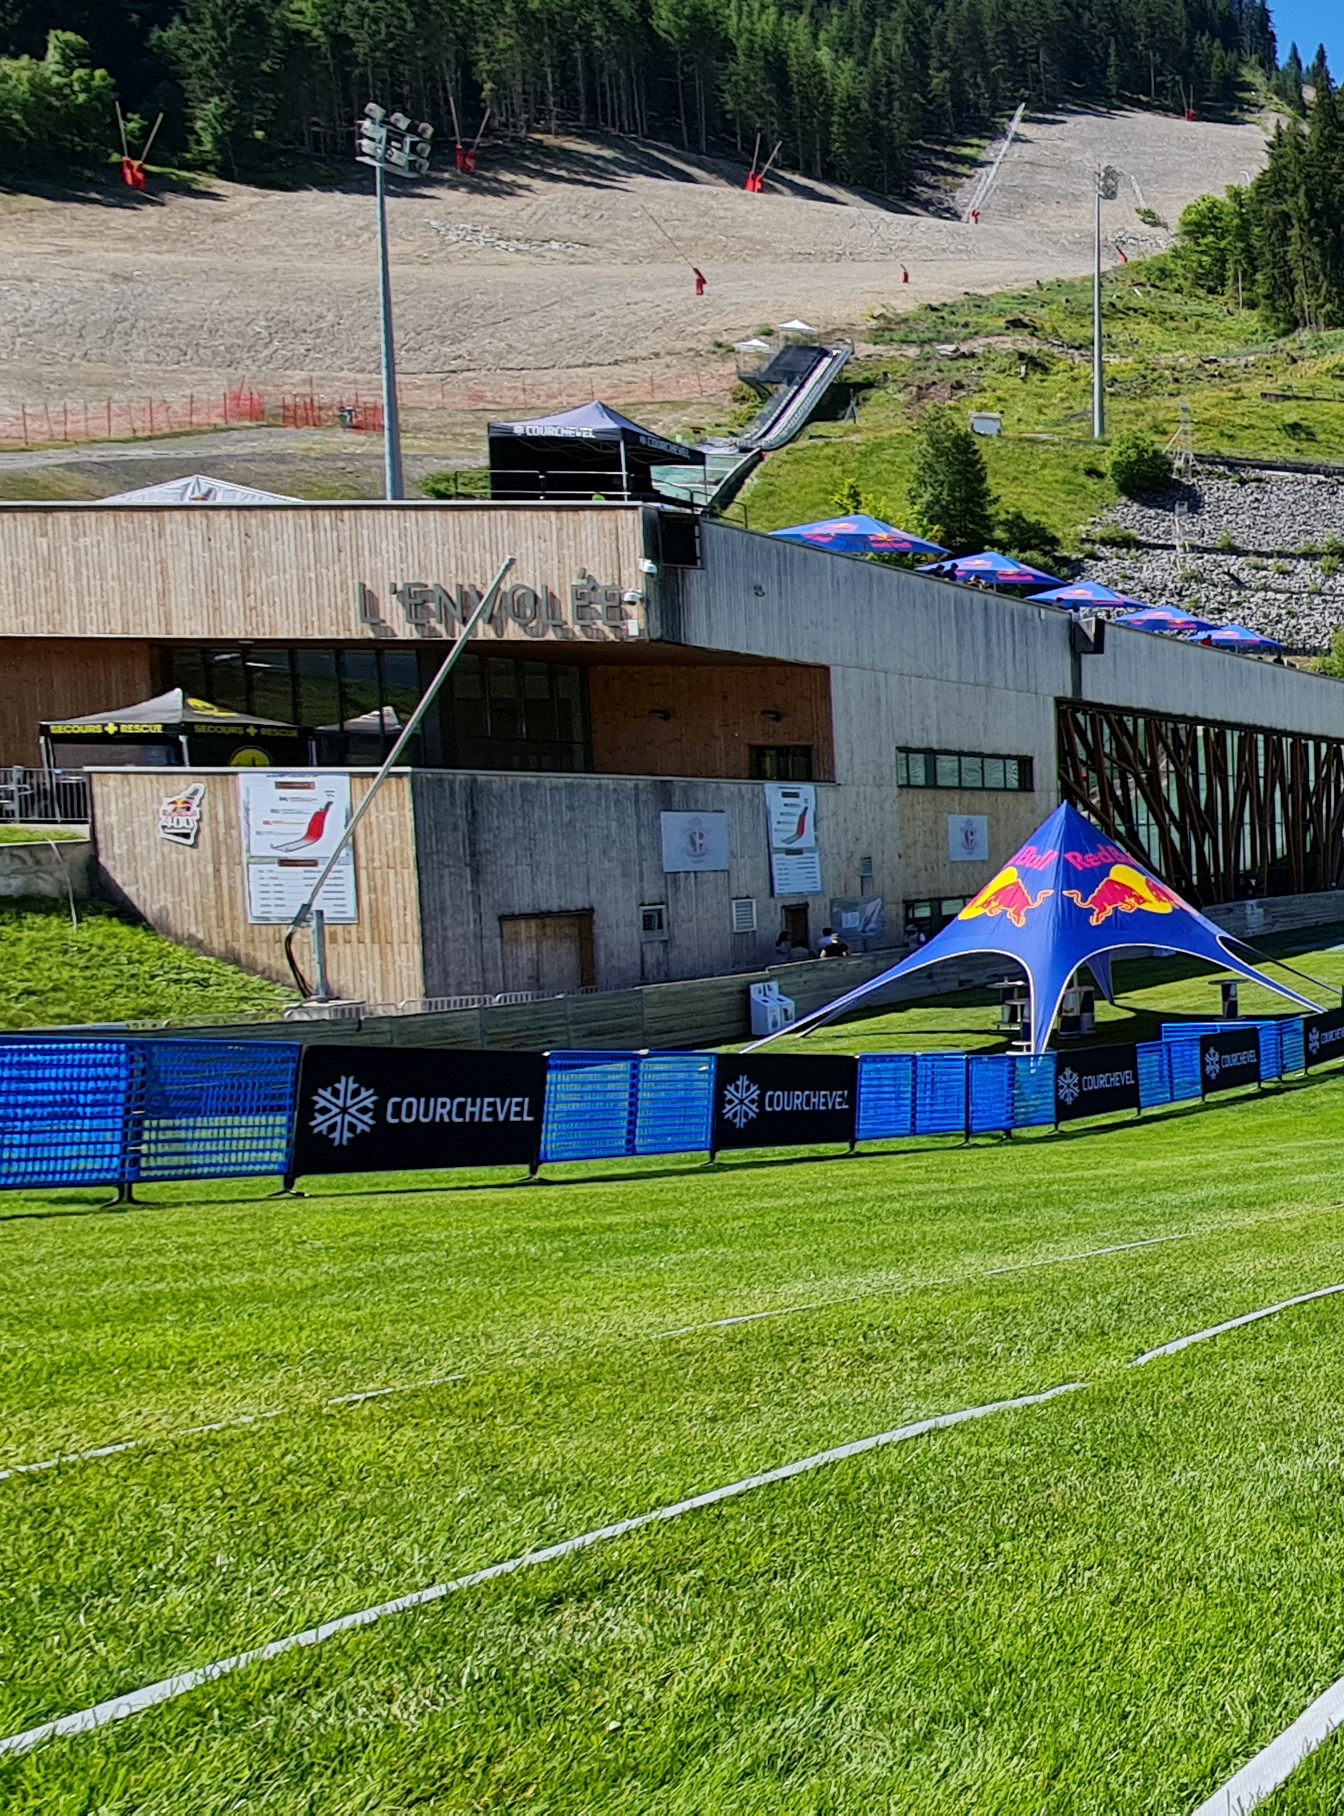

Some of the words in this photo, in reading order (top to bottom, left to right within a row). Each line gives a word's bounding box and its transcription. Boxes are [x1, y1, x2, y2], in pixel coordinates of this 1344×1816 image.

[50, 725, 103, 734] SECOURS
[119, 724, 164, 734] RESCUE
[1081, 1070, 1136, 1092] COURCHEVEL
[386, 1097, 535, 1123] COURCHEVEL
[765, 1090, 849, 1112] COURCHEVEL
